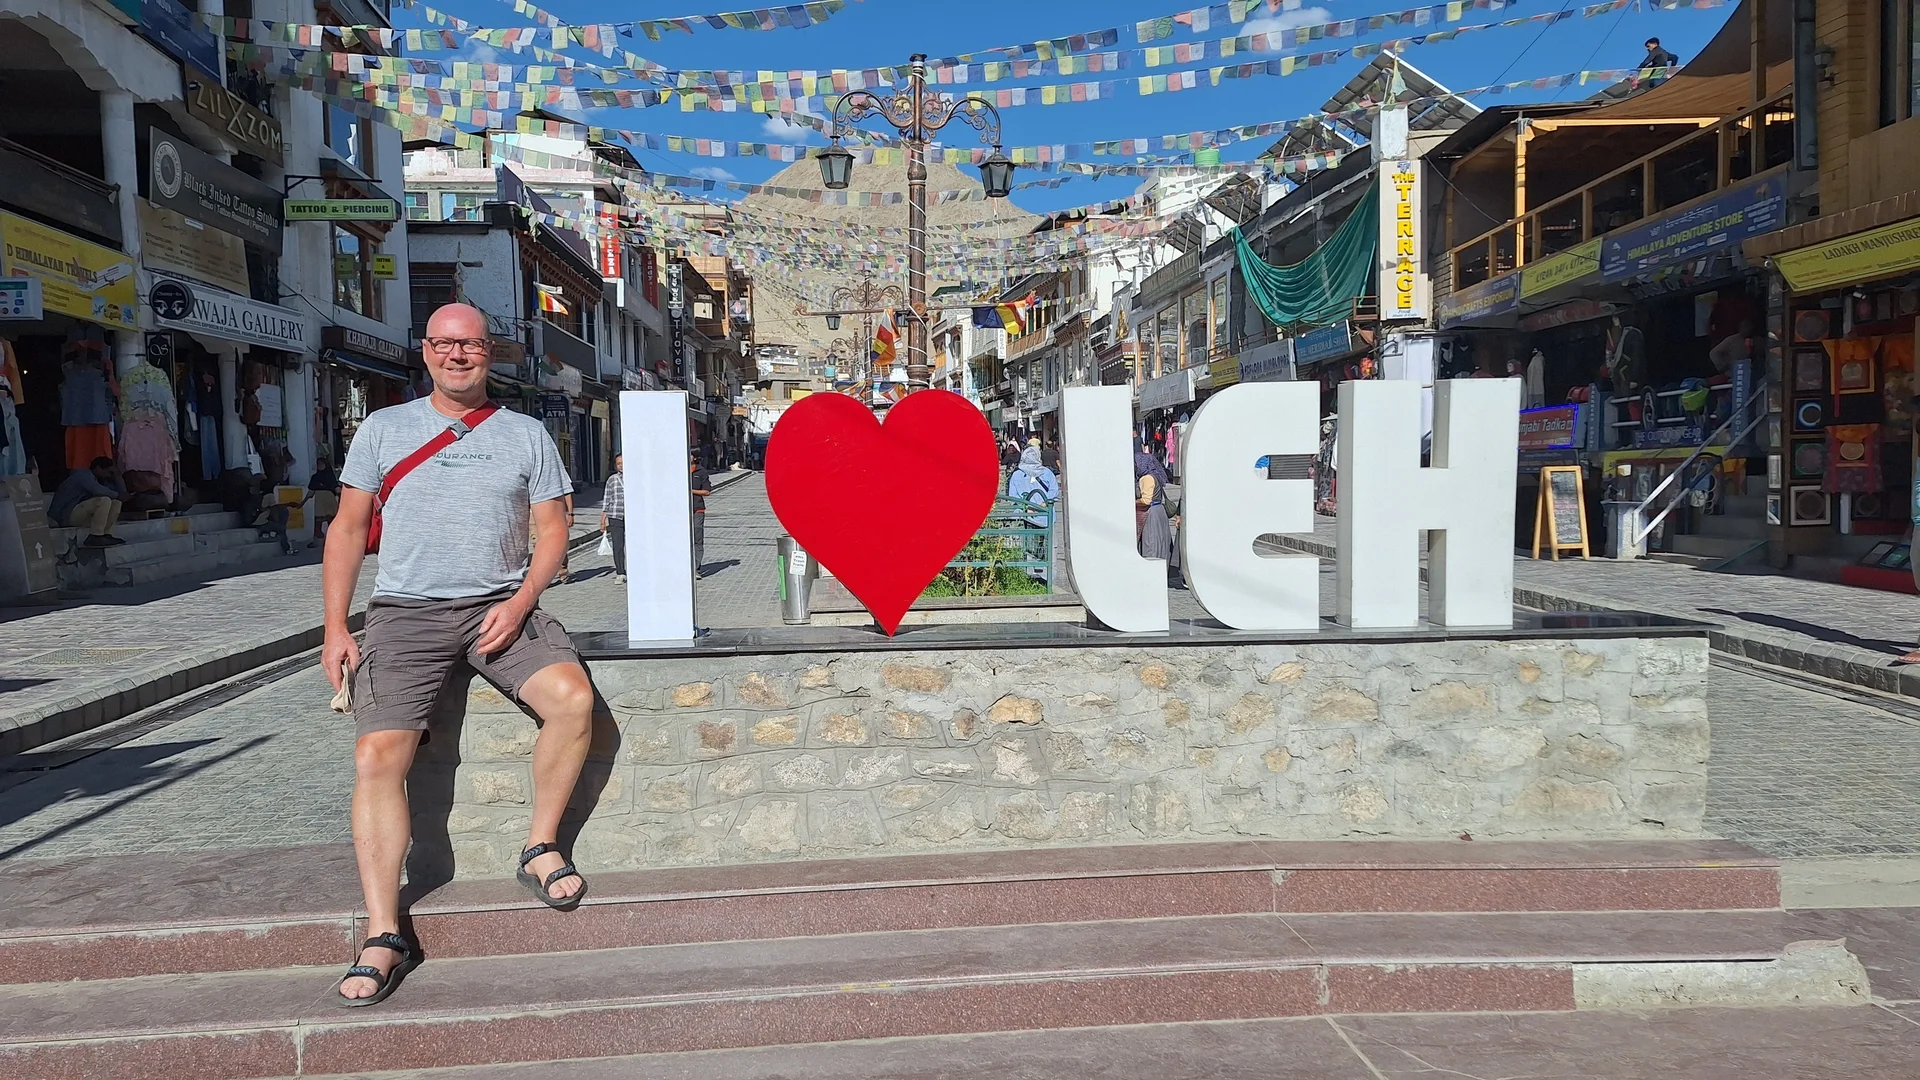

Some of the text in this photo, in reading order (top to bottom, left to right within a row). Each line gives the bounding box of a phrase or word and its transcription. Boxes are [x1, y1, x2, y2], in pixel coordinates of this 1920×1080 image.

[1392, 173, 1416, 183] THE
[184, 172, 279, 229] Black Inked Tattoo Studio
[290, 205, 389, 214] TATTOO & PIERCING
[1396, 184, 1414, 309] TERRACE
[1627, 239, 1665, 261] HIMALAYA
[1665, 220, 1714, 249] ADVENTURE
[1714, 210, 1744, 231] STORE
[6, 243, 98, 284] D HIMALAYAN TRAVELS
[1821, 243, 1862, 260] LADAKH
[242, 310, 304, 342] GALLERY
[346, 329, 377, 350] KHAWAJA
[378, 339, 403, 360] GALLERY
[673, 319, 682, 374] Travel
[546, 410, 566, 418] ATM
[1519, 417, 1566, 435] njabi Tadka
[435, 452, 493, 461] DURANCE
[619, 377, 1522, 643] I LEH
